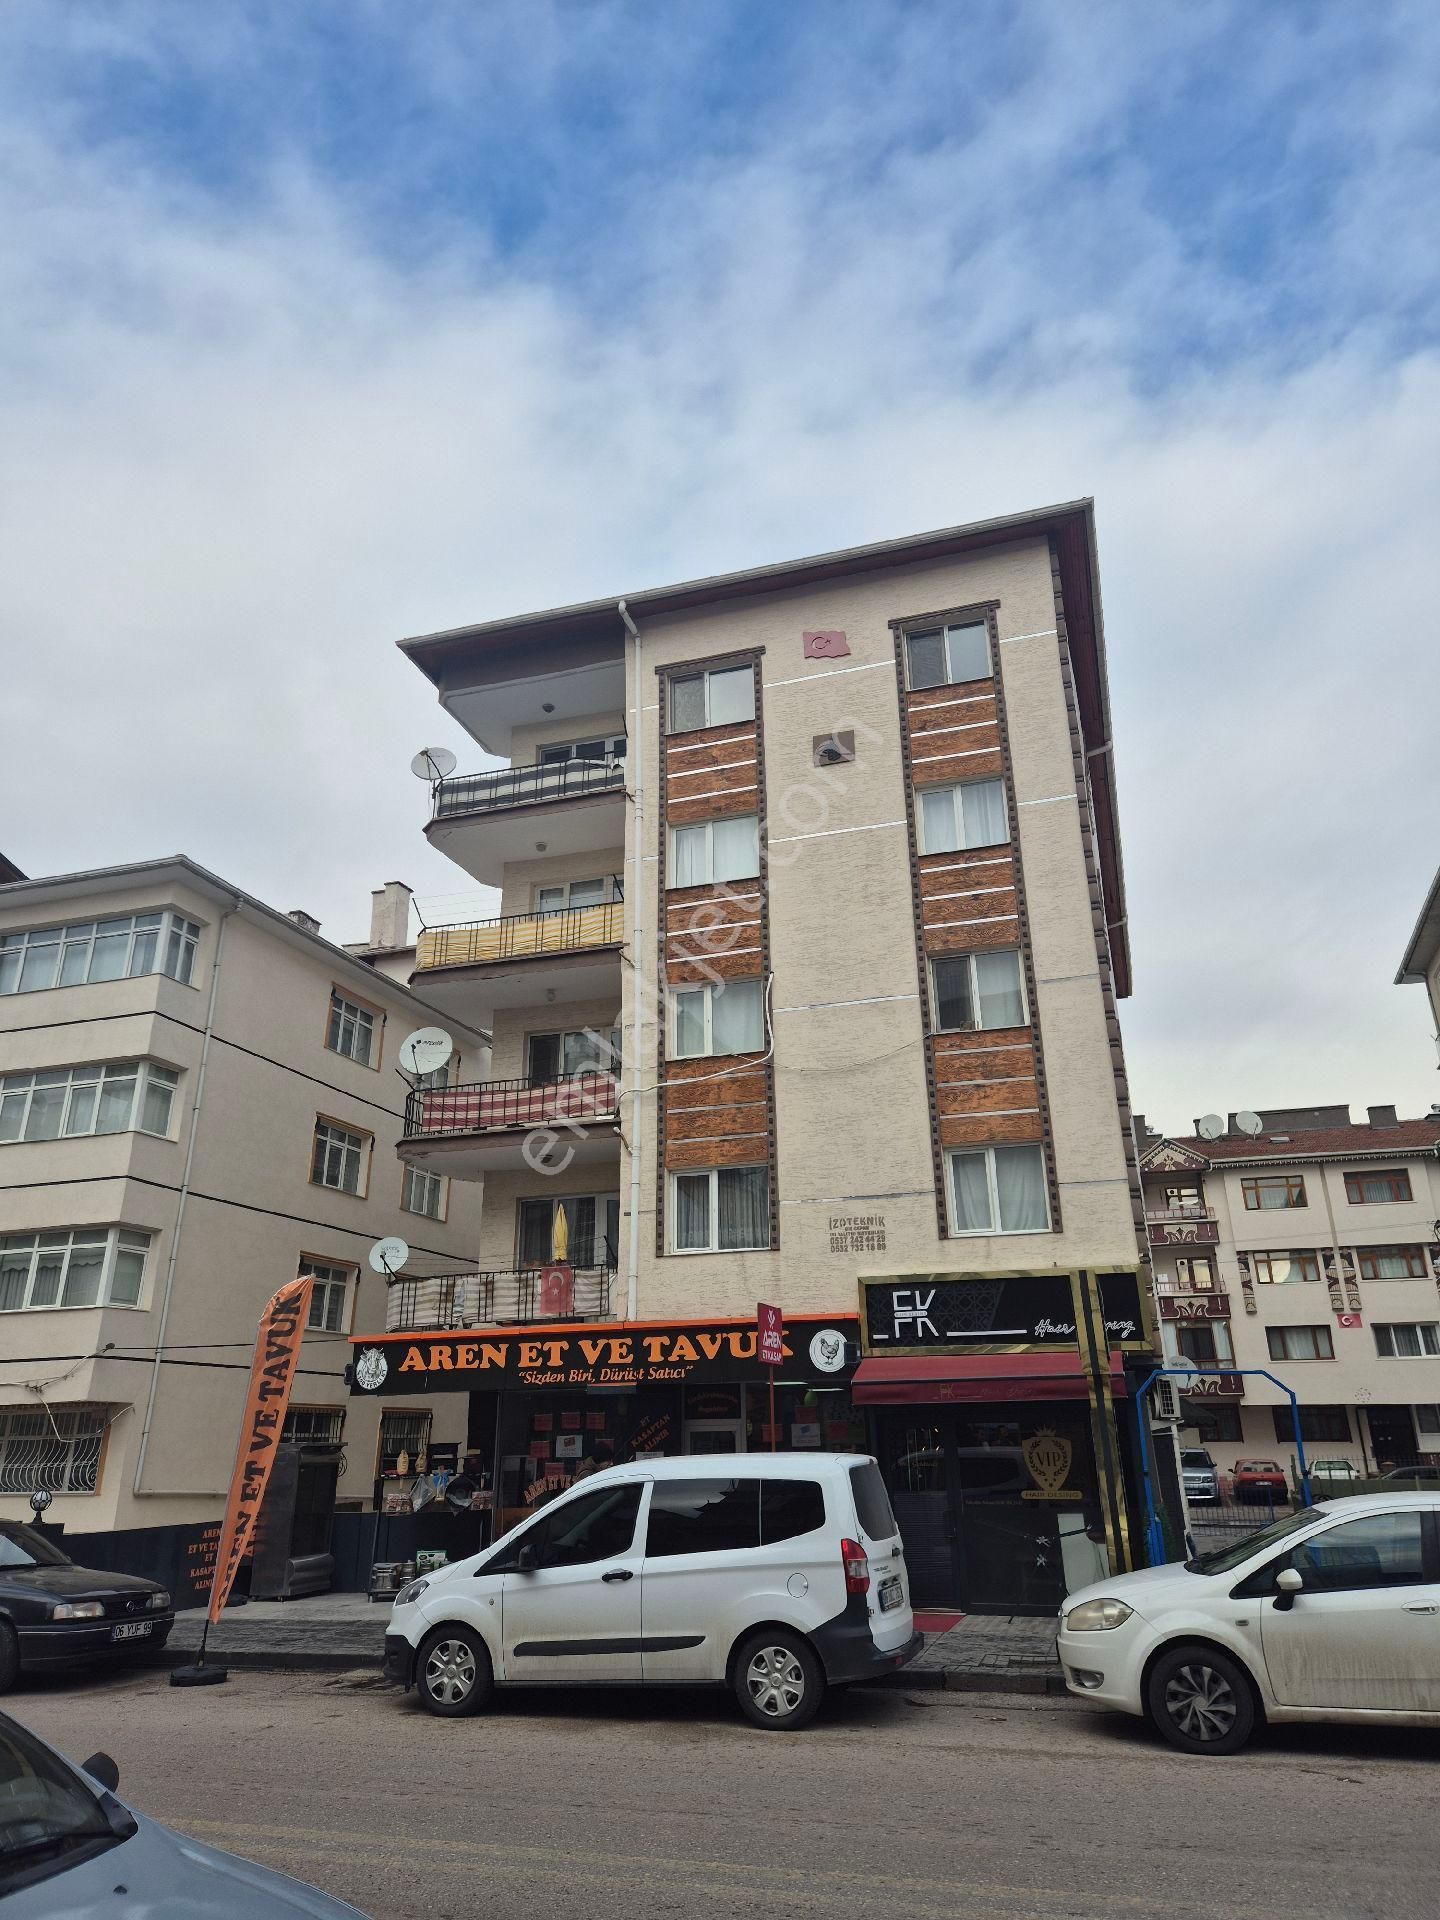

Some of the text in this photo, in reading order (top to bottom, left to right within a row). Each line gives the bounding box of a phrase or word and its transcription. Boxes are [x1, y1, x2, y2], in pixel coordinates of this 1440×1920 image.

[258, 1292, 303, 1404] TAVUK
[398, 1343, 510, 1372] AREN
[517, 1341, 570, 1368] ET
[577, 1337, 634, 1365] VE
[568, 1367, 596, 1383] Biri,
[599, 1366, 645, 1382] Dürüst
[250, 1408, 280, 1454] VE
[1034, 1451, 1061, 1467] VIP
[240, 1460, 266, 1503] ET
